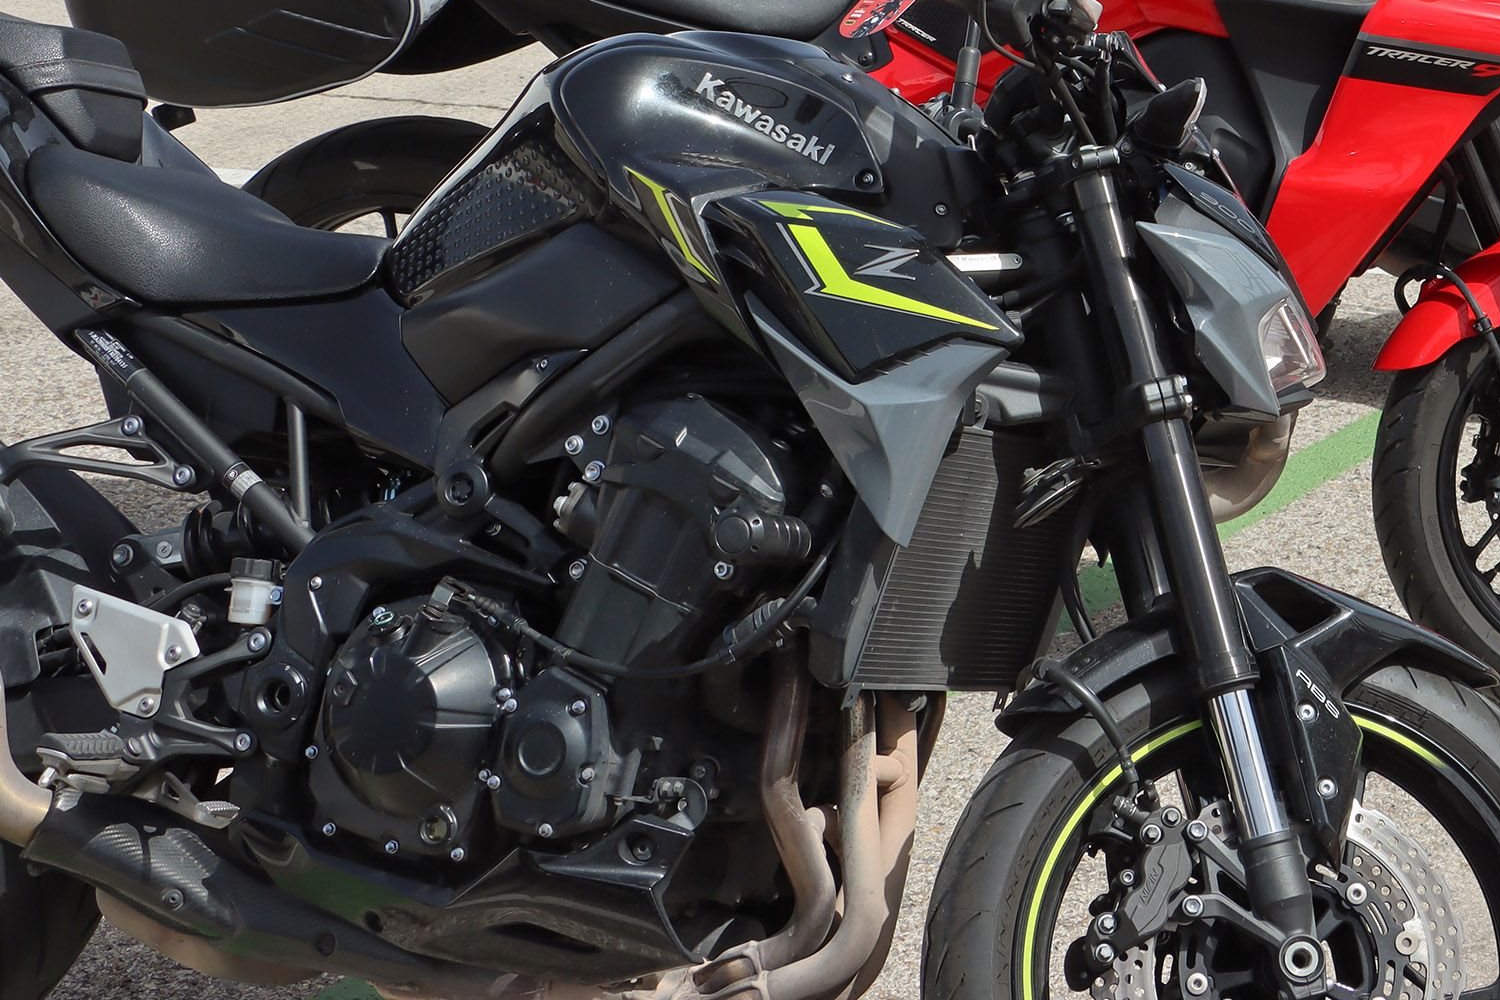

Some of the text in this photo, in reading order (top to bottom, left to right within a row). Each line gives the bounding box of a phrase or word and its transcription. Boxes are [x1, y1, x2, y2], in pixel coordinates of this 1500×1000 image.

[897, 17, 937, 42] TRACER
[1366, 46, 1476, 70] TRACER
[695, 72, 836, 166] Kawasaki
[1200, 191, 1256, 234] 900
[1295, 669, 1340, 719] ABS
